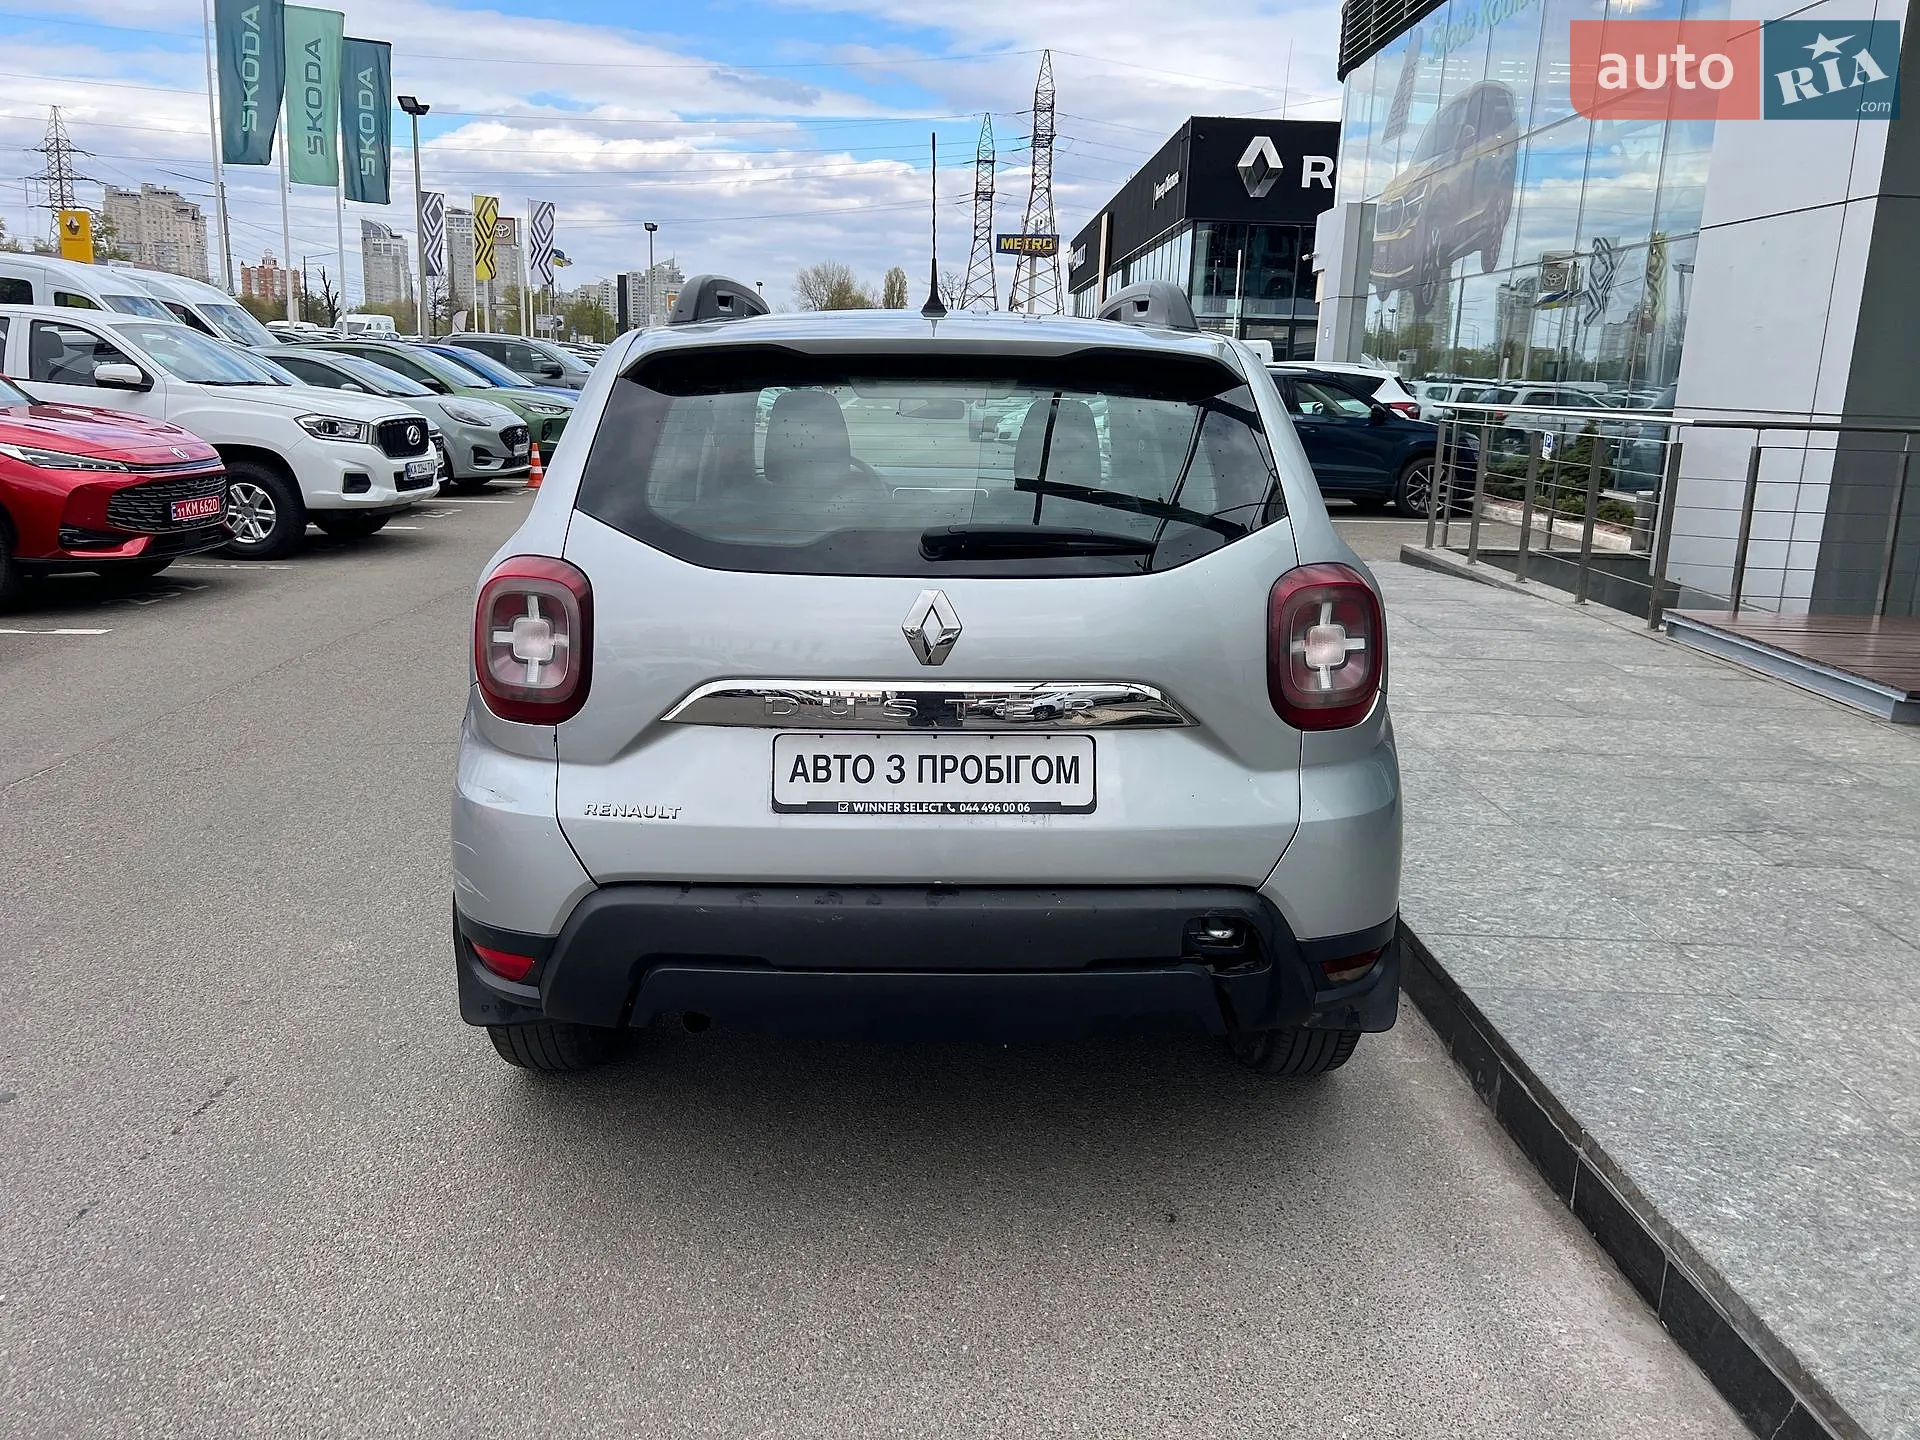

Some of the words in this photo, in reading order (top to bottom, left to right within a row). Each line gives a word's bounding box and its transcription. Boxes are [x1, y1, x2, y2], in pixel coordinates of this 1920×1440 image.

[1001, 237, 1054, 250] METRO
[764, 696, 1096, 721] DUSTER
[789, 754, 875, 784] АВТО
[917, 755, 1080, 784] ПРОБІГОМ
[584, 803, 682, 819] RENAULT
[853, 802, 902, 812] WINNER
[903, 802, 943, 812] SELECT
[959, 803, 979, 813] 044
[980, 803, 1001, 813] 496
[1003, 803, 1016, 813] 00
[1018, 803, 1030, 813] 06
